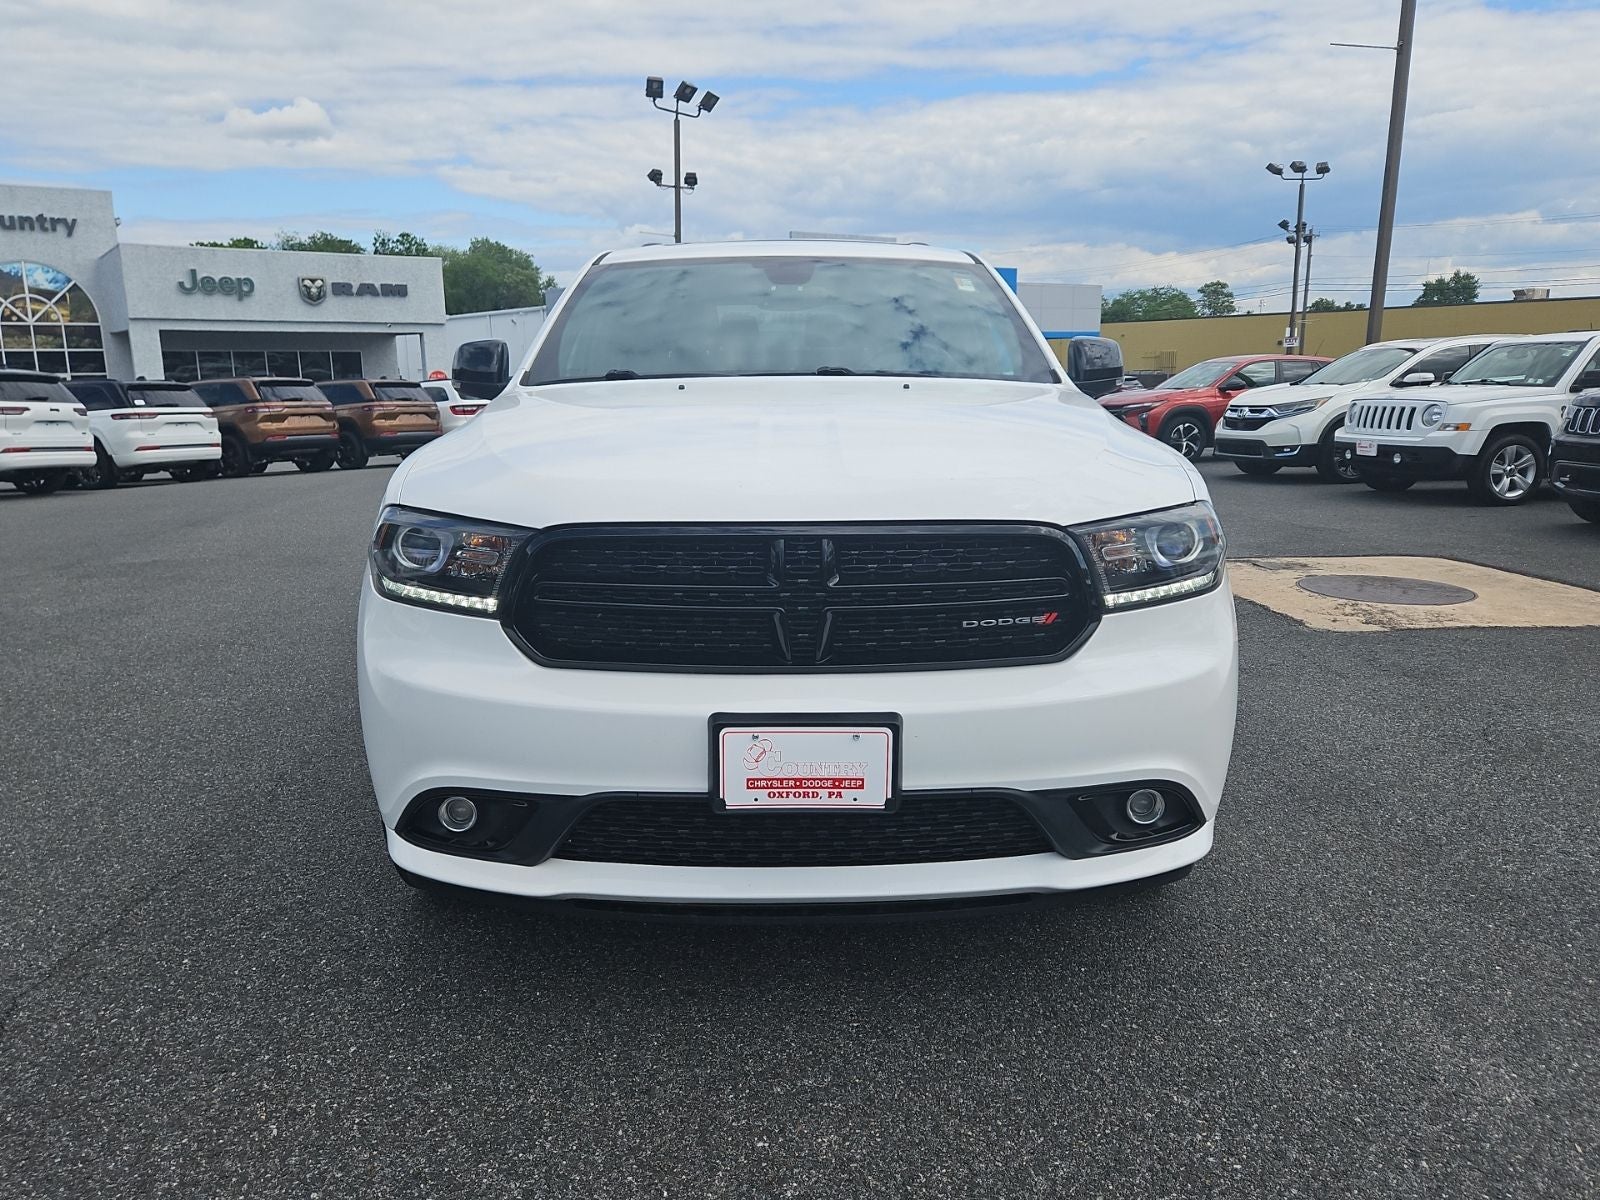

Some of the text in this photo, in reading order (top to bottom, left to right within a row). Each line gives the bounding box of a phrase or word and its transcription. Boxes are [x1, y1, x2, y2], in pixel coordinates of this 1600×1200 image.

[178, 268, 255, 301] Jeep
[331, 281, 408, 298] RAM
[962, 616, 1046, 628] DODGE
[748, 779, 863, 788] CHRYSLER DODGE JEEP
[767, 790, 843, 800] OXFORD, PA
